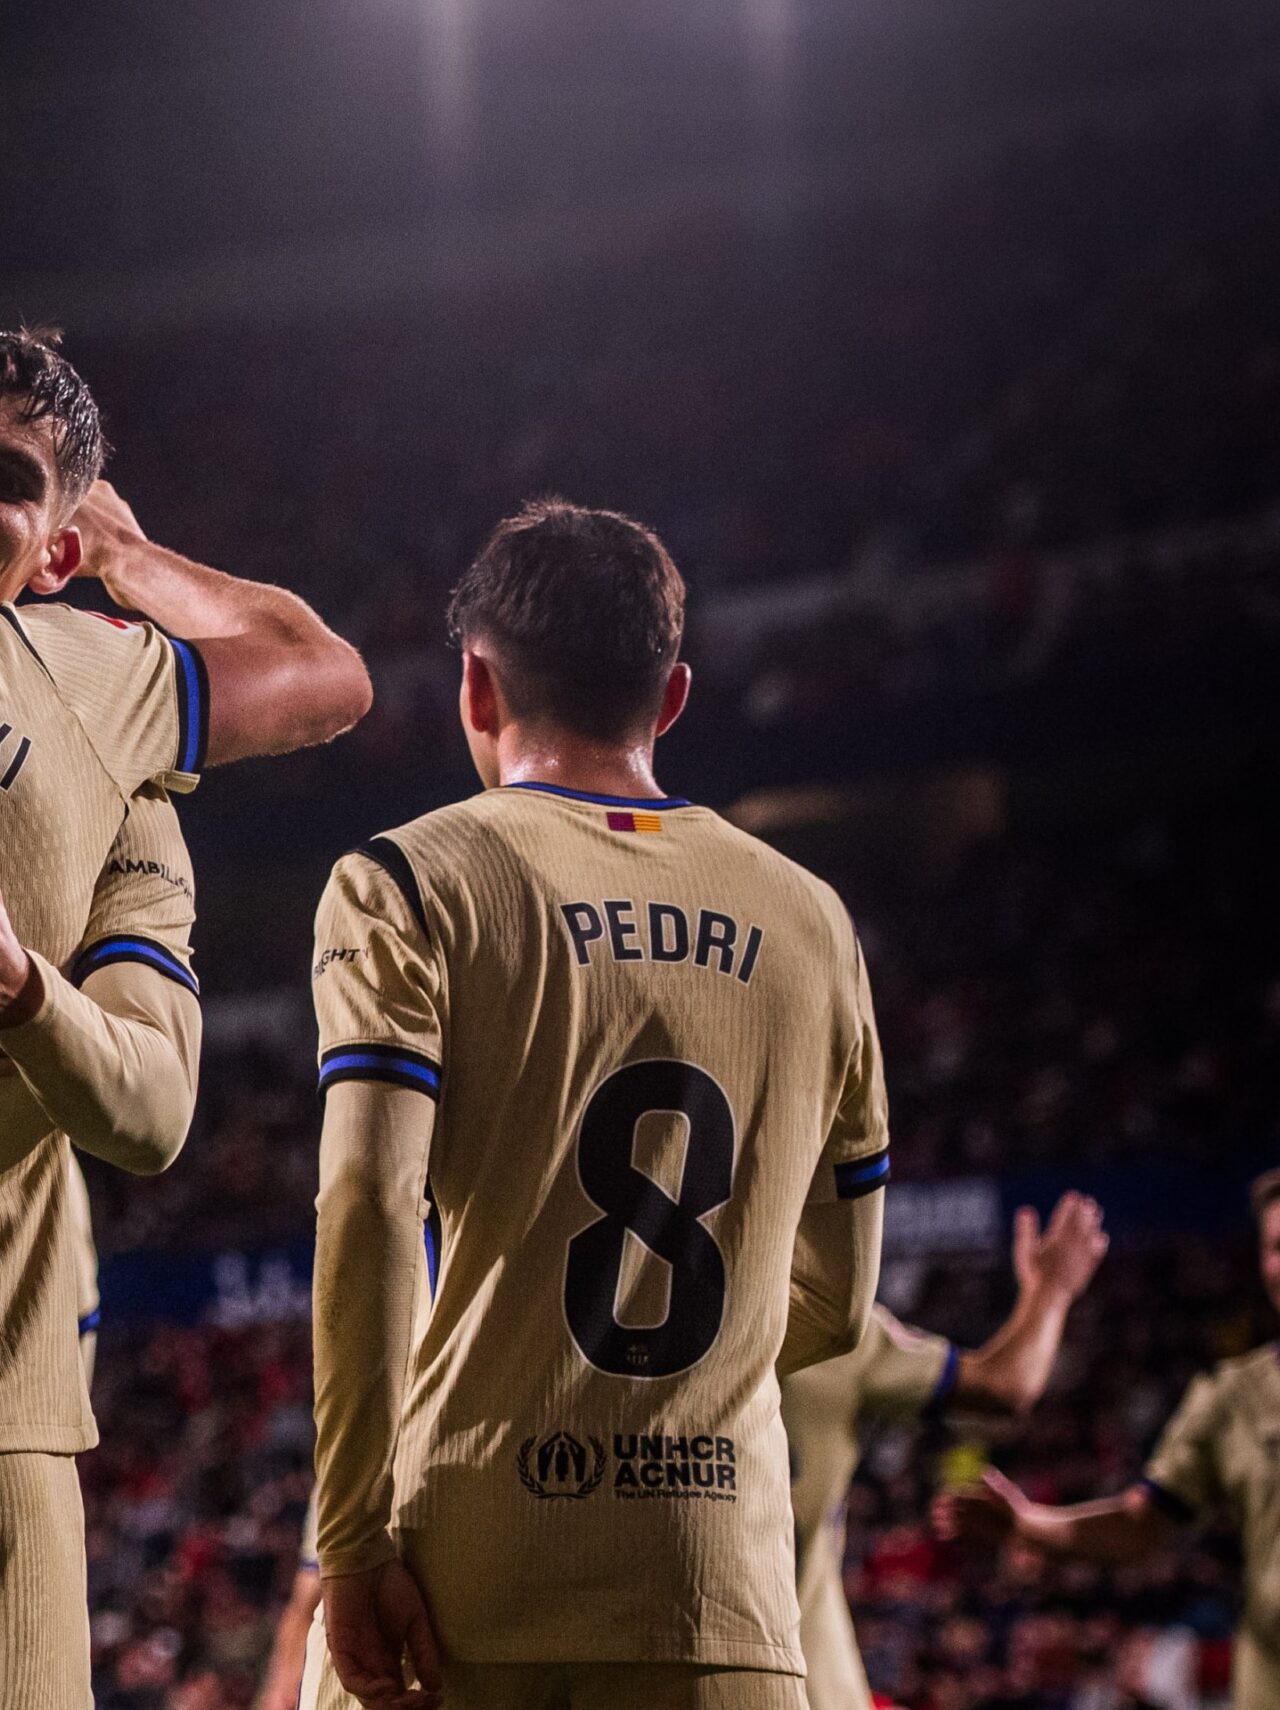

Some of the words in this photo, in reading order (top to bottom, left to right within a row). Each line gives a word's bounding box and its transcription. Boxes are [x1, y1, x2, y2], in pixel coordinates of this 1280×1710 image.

[561, 900, 763, 987] PEDRI
[564, 1058, 736, 1380] 8
[613, 1434, 736, 1462] UNHCR
[614, 1462, 736, 1490] ACNUR
[615, 1489, 635, 1499] The
[637, 1489, 655, 1499] UN
[657, 1489, 701, 1499] Refugee
[703, 1490, 736, 1503] Agency
